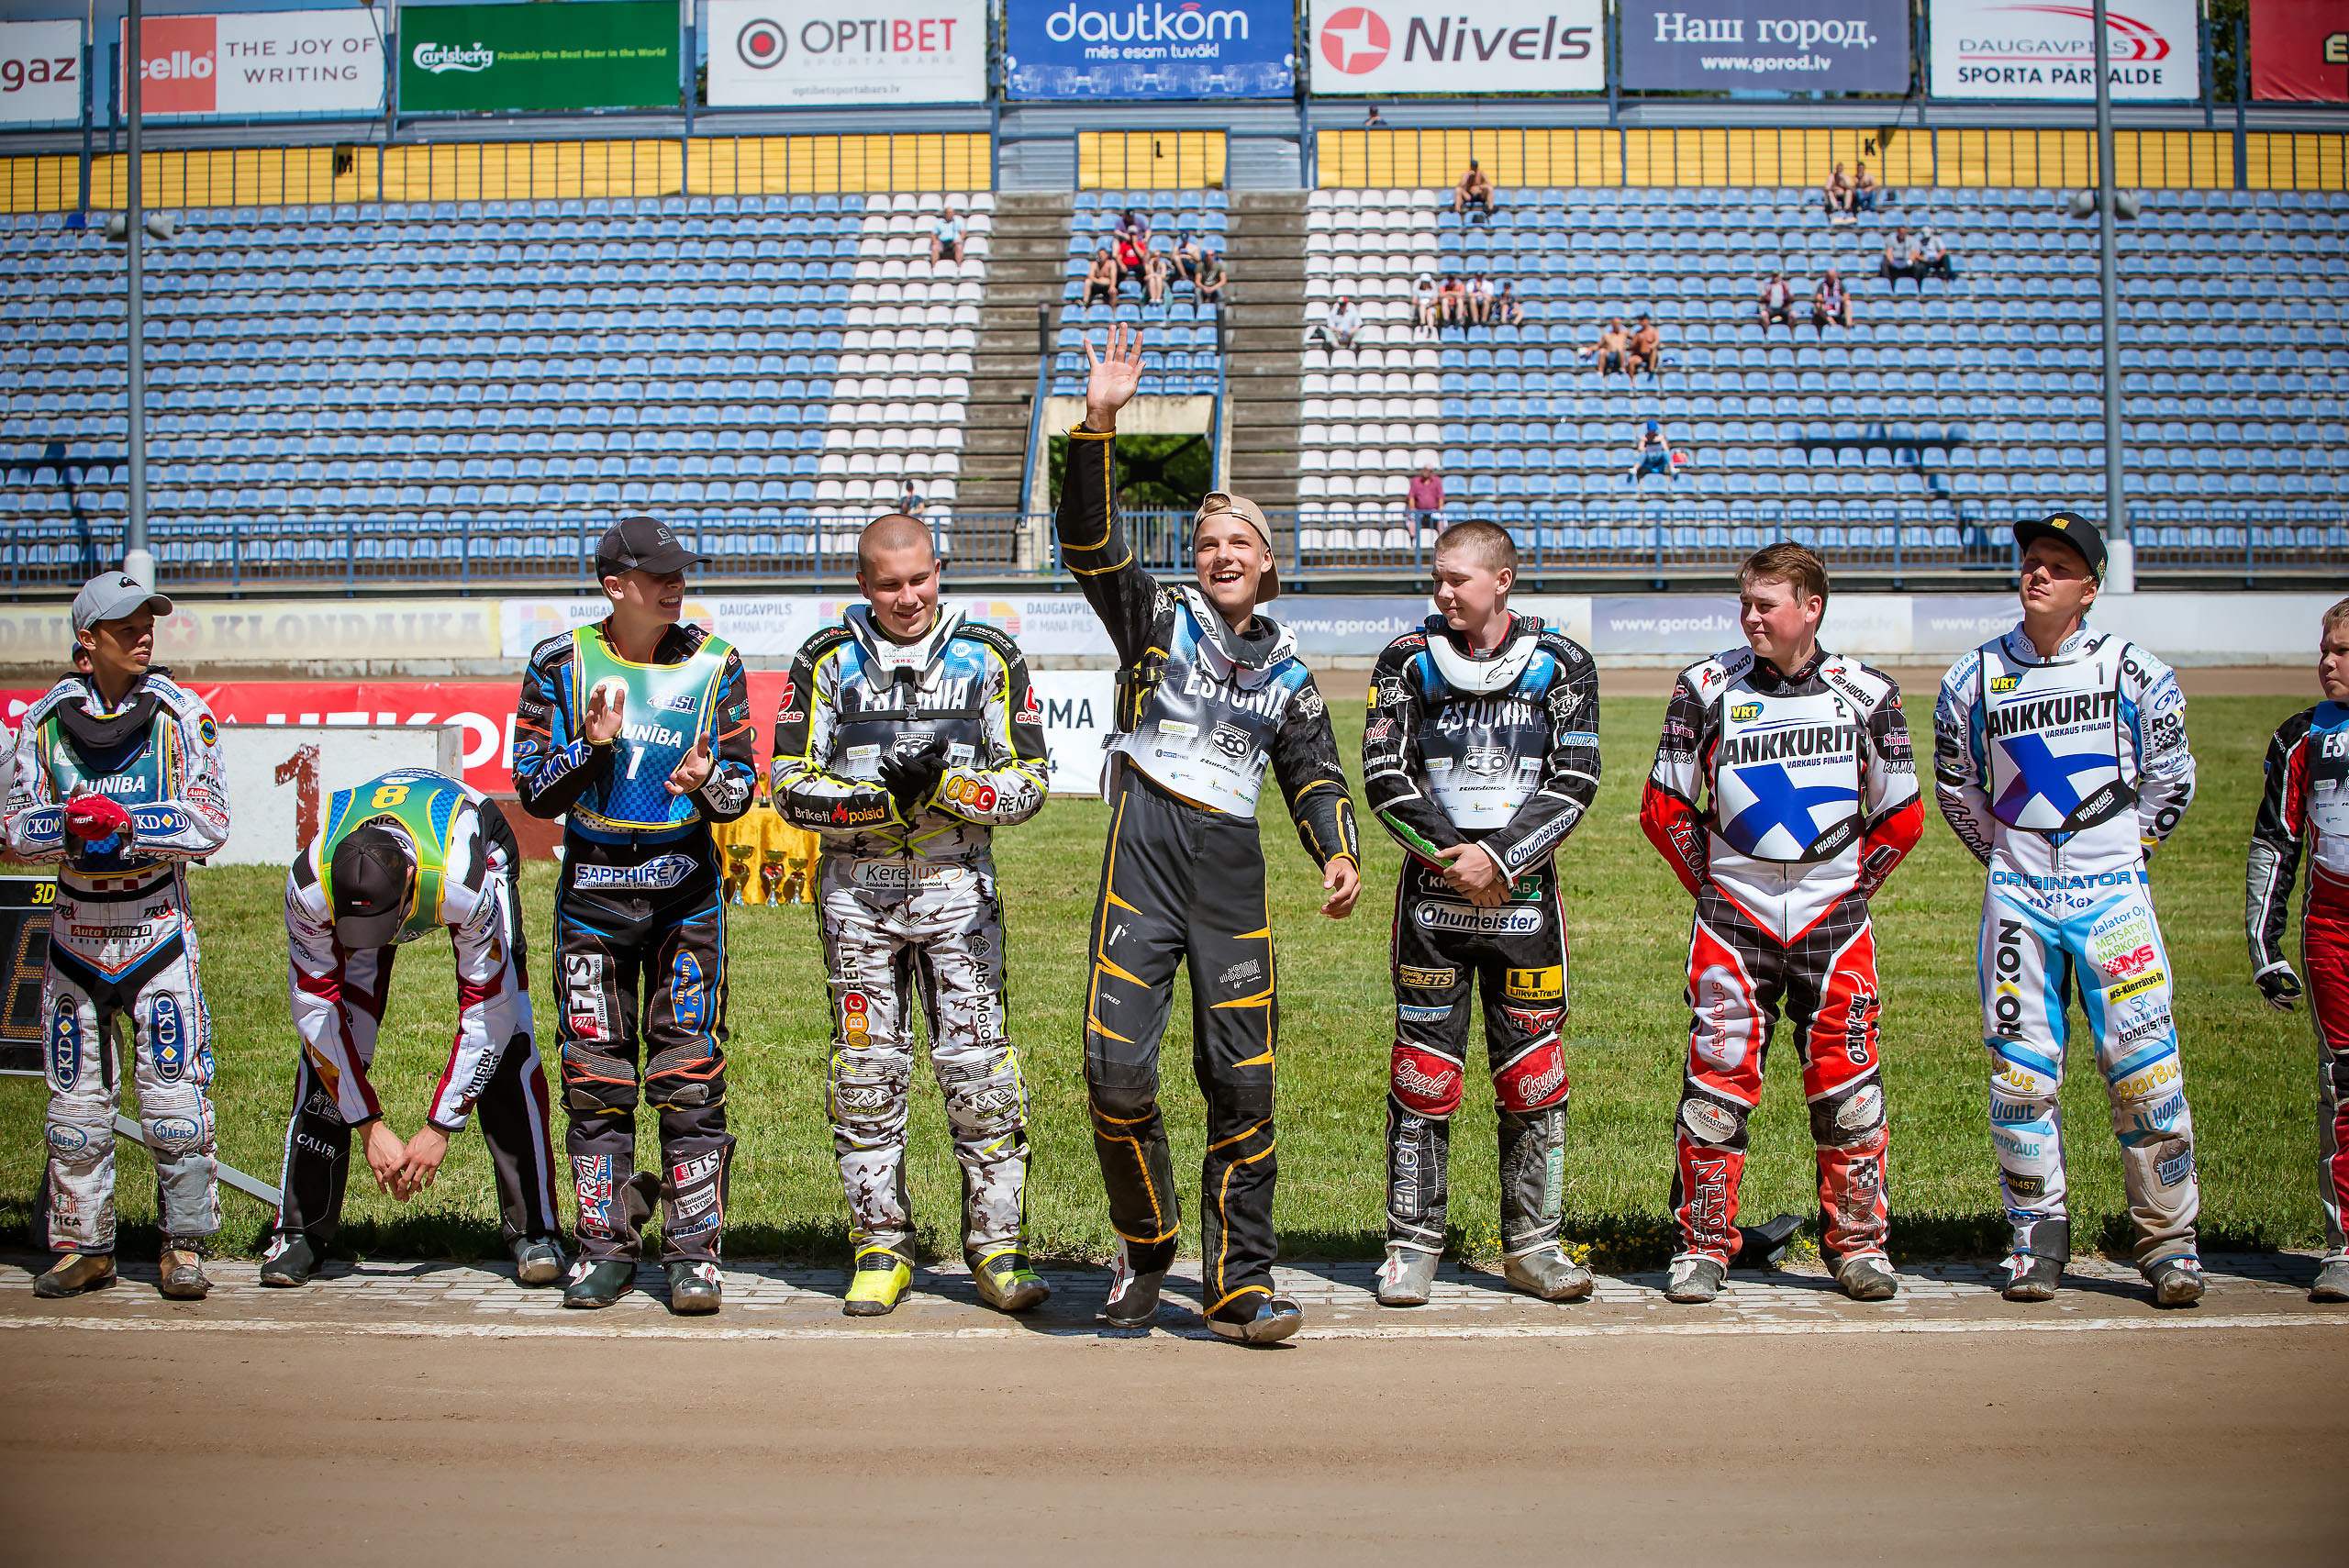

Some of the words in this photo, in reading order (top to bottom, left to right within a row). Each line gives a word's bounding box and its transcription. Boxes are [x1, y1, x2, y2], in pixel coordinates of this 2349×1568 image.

[1046, 2, 1249, 42] dautkom
[1653, 13, 1744, 42] Наш
[1756, 19, 1878, 50] город.
[801, 18, 957, 53] OPTIBET
[1404, 16, 1593, 61] Nivels
[1959, 39, 2128, 53] DAUGAVPIS
[226, 41, 276, 58] THE
[286, 39, 334, 55] JOY
[342, 38, 376, 53] OF
[413, 42, 494, 73] Carlsberg
[497, 51, 540, 61] Probably
[542, 50, 558, 60] the
[560, 50, 582, 59] Best
[584, 49, 606, 59] Beer
[608, 49, 618, 58] in
[619, 48, 635, 58] the
[638, 48, 667, 58] World
[1085, 45, 1119, 60] mēs
[1123, 47, 1166, 60] esam
[244, 65, 359, 84] WRITING
[1700, 55, 1831, 72] www.gorod.lv
[1958, 67, 2043, 83] SPORTA
[2052, 62, 2164, 84] PĀRALDE
[1156, 141, 1163, 158] L
[1865, 138, 1876, 158] K
[338, 154, 353, 174] M
[719, 603, 792, 617] DAUGAVPILS
[1027, 602, 1097, 616] DAUGAVPIL
[732, 619, 762, 633] MANA
[763, 619, 785, 632] PILS
[1039, 620, 1067, 632] MANA
[1070, 620, 1093, 632] PILS
[1286, 617, 1410, 636] www.gorod.lv
[1610, 615, 1733, 635] www.gorod.lv
[1991, 676, 2018, 692] VRT
[2096, 662, 2104, 685] 1
[46, 686, 67, 704] METAL
[145, 678, 158, 689] AST
[157, 683, 179, 700] METAL
[860, 677, 969, 711] ESTNIA
[1184, 671, 1293, 718] ESTONIA
[1731, 704, 1760, 719] VRT
[1833, 696, 1848, 718] 2
[1989, 690, 2116, 740] ANKKURIT
[620, 724, 683, 749] UNĪBA
[2044, 727, 2080, 740] VARKAUS
[2080, 721, 2111, 734] FINLAND
[1213, 730, 1248, 756] 360
[1725, 724, 1858, 766] ANKKURIT
[626, 746, 645, 780] 1
[1466, 755, 1507, 771] 360
[1787, 757, 1821, 769] VARKAUS
[1822, 754, 1854, 765] FINLAND
[274, 742, 320, 852] 1
[371, 784, 412, 809] 8
[998, 793, 1036, 815] RENT
[2076, 787, 2115, 823] WARKAUS
[795, 806, 830, 823] Briketi
[1510, 810, 1578, 865] Õhumeister
[1813, 822, 1850, 854] WARKAUS
[575, 879, 631, 888] ENGINEERING
[655, 879, 671, 888] LTD
[576, 865, 670, 884] SAPPHIRE
[865, 863, 941, 882] Kerelux
[1992, 871, 2132, 891] ORIGINATOR
[1421, 903, 1538, 931] Õhumeister
[2093, 909, 2132, 937] Jalator
[2132, 905, 2146, 919] Oy
[72, 927, 103, 937] Auto
[2095, 918, 2148, 951] METSÄTYÖ
[2097, 936, 2143, 964] MARKOP
[2142, 929, 2154, 943] OY
[839, 945, 861, 992] RENT
[974, 962, 989, 994] Abc
[1510, 970, 1548, 989] LT
[1995, 918, 2022, 1038] ROXON
[2126, 964, 2146, 977] STORE
[674, 956, 694, 1006] Catering
[2110, 973, 2157, 1001] MS-Kierrätys
[1510, 1015, 1557, 1031] RENO
[844, 1105, 890, 1116] design
[975, 1100, 1018, 1120] design
[687, 1150, 719, 1176] FTS
[1394, 1111, 1426, 1194] Metus
[1549, 1156, 1561, 1210] PREFAB
[674, 1221, 706, 1240] TEAM
